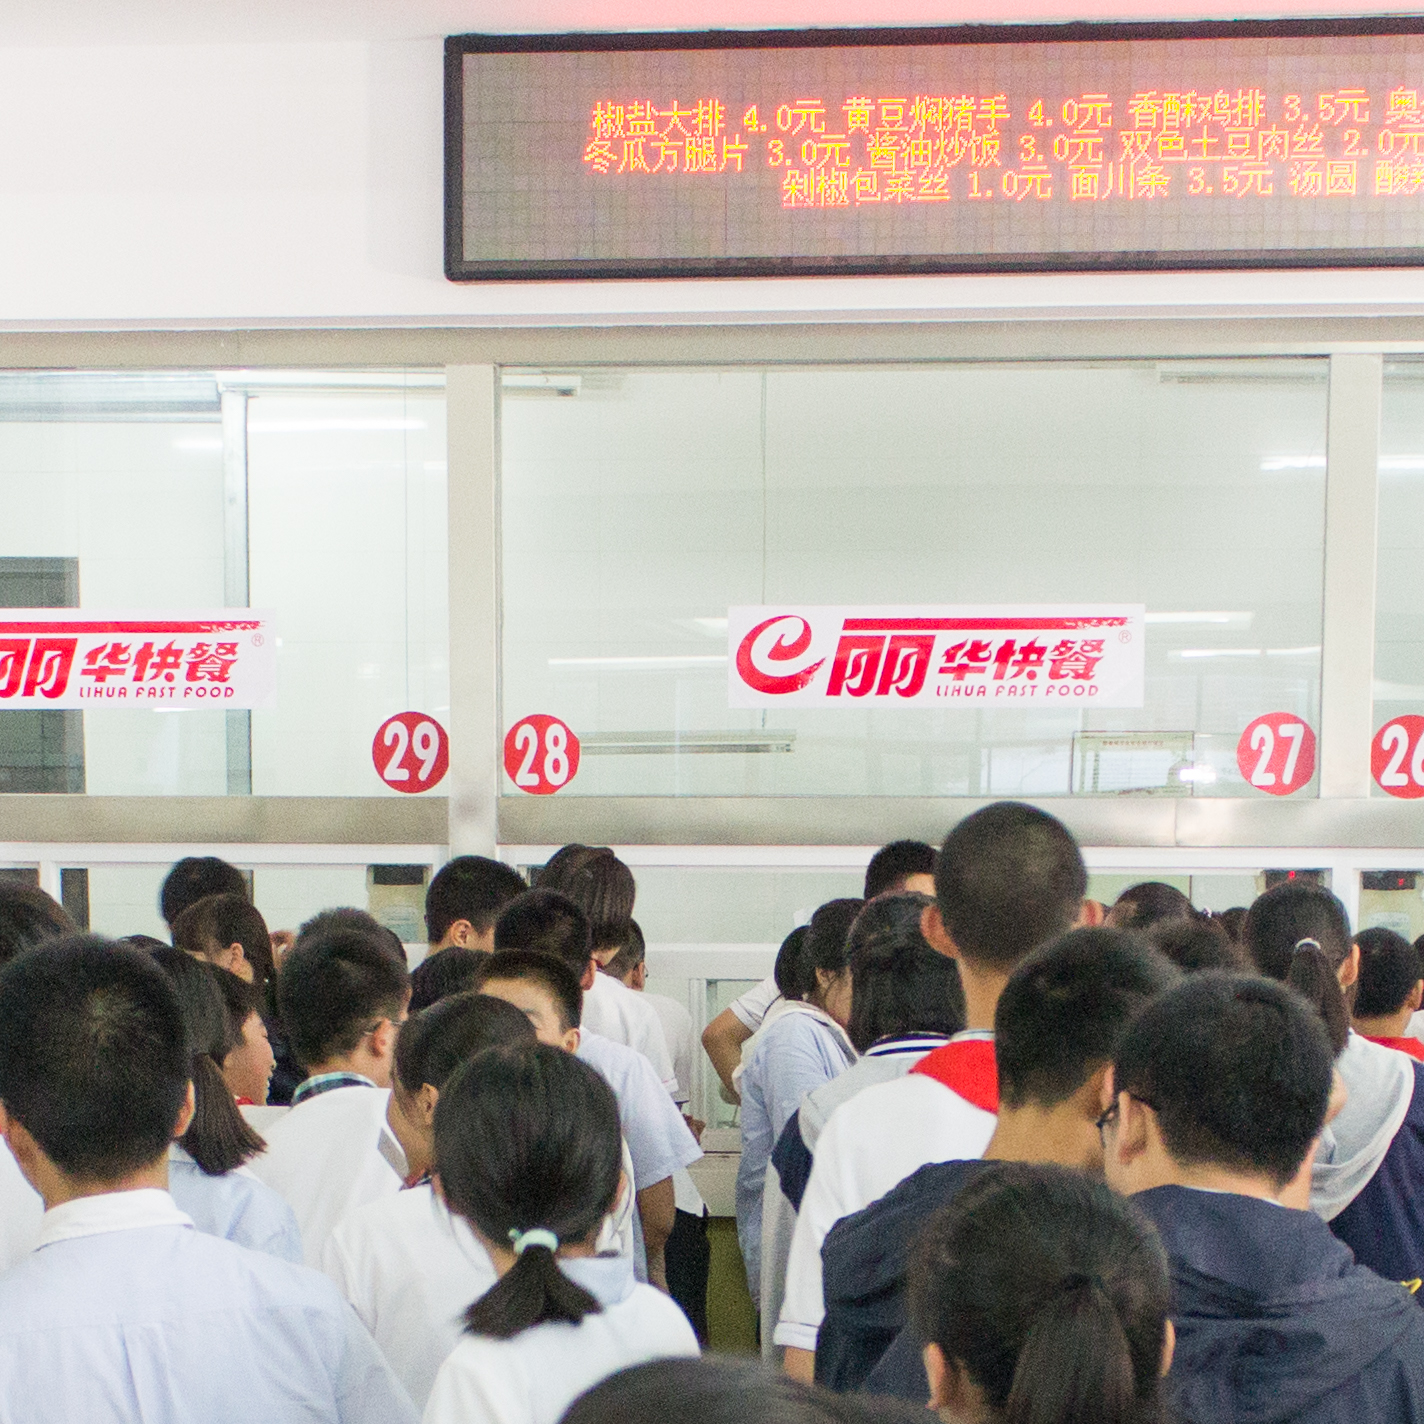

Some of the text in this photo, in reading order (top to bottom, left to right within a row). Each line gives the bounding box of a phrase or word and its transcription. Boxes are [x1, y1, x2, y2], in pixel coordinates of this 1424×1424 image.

[591, 98, 726, 137] 椒盐大排
[742, 99, 827, 136] 4.0元
[841, 94, 1012, 134] 黄豆焖猪手
[1027, 93, 1114, 131] 4.0元
[1127, 88, 1268, 130] 香酥鸡排
[1283, 88, 1371, 127] 3.5元
[583, 133, 749, 174] 冬瓜方腿片
[766, 132, 852, 170] 3.0元
[866, 131, 1002, 171] 酱油炒饭
[1018, 128, 1105, 166] 3.0元
[1118, 124, 1327, 164] 双色土豆肉丝
[782, 166, 951, 206] 剁椒包菜丝
[967, 164, 1054, 201] 1.0元
[1187, 160, 1276, 198] 3.5元
[1288, 160, 1358, 198] 汤圆
[79, 686, 234, 699] LIHUA FAST FOOD
[935, 685, 1099, 698] LIHUA FAST FOOD
[383, 720, 440, 781] 29
[515, 723, 569, 786] 28
[1250, 723, 1304, 786] 27
